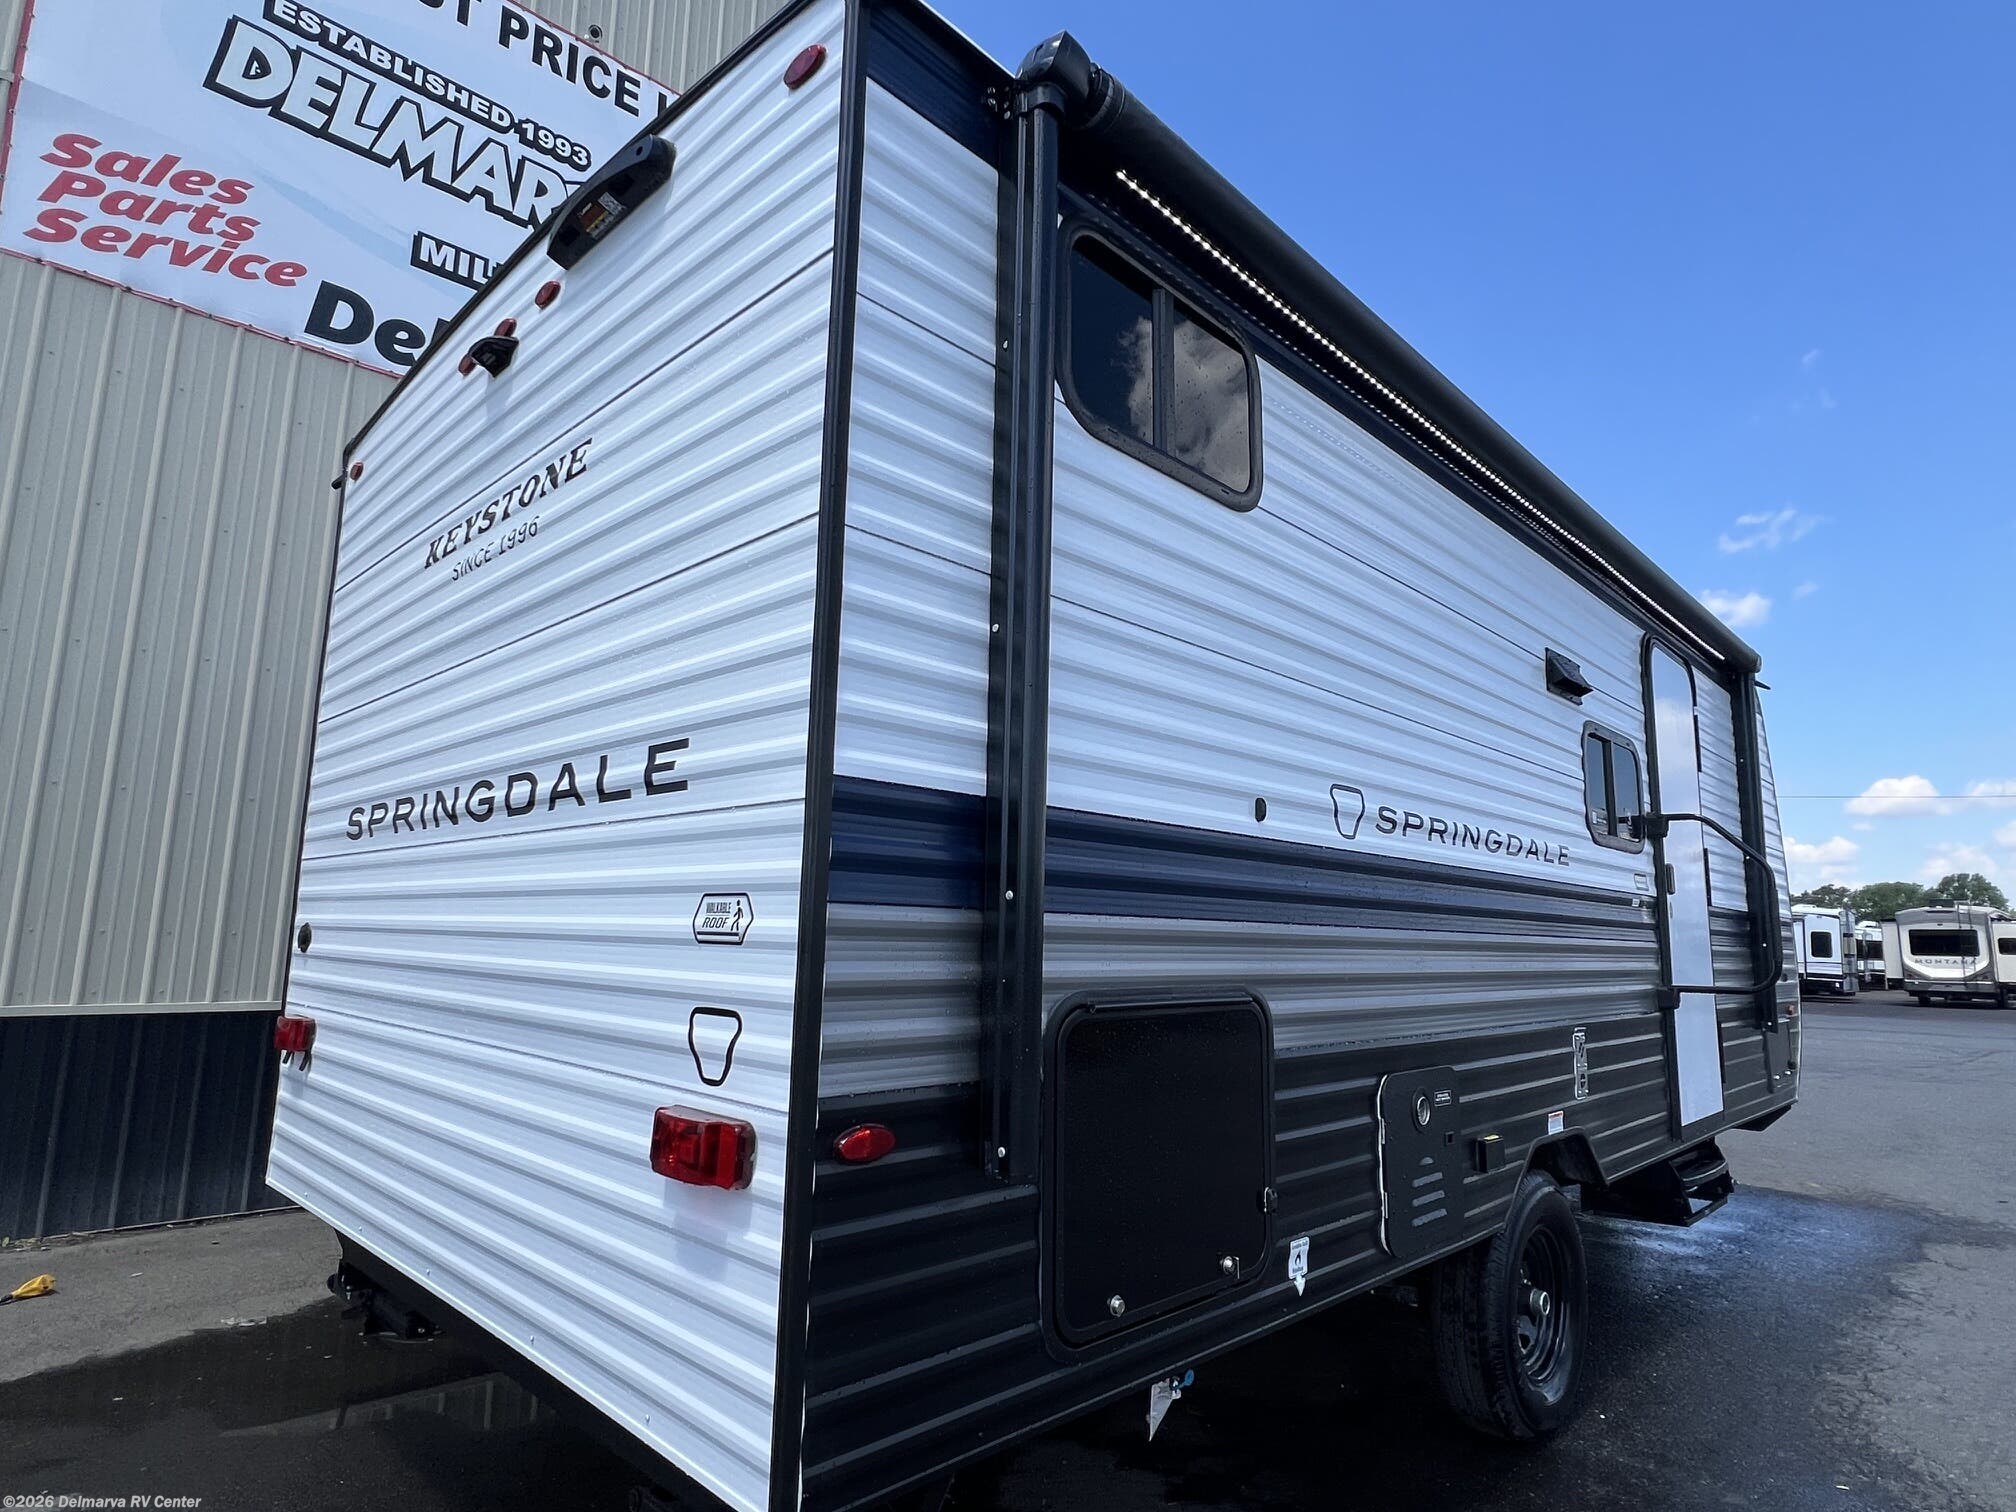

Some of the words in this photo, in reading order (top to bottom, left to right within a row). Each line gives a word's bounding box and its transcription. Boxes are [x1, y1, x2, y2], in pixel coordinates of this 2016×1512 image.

[272, 0, 512, 129] ESTABLISHED
[520, 121, 590, 167] 1993
[418, 0, 482, 26] T
[499, 5, 641, 117] PRICE
[205, 16, 588, 228] DELMAR
[37, 170, 261, 242] Parts
[39, 133, 255, 204] Sales
[22, 208, 308, 287] Service
[417, 234, 497, 284] MIL
[424, 437, 593, 570] KEYSTONE
[452, 541, 495, 581] SINCE
[499, 514, 540, 556] 1996
[346, 737, 690, 840] SPRINGDALE
[1375, 805, 1571, 867] SPRINGDALE
[702, 916, 730, 929] ROOF
